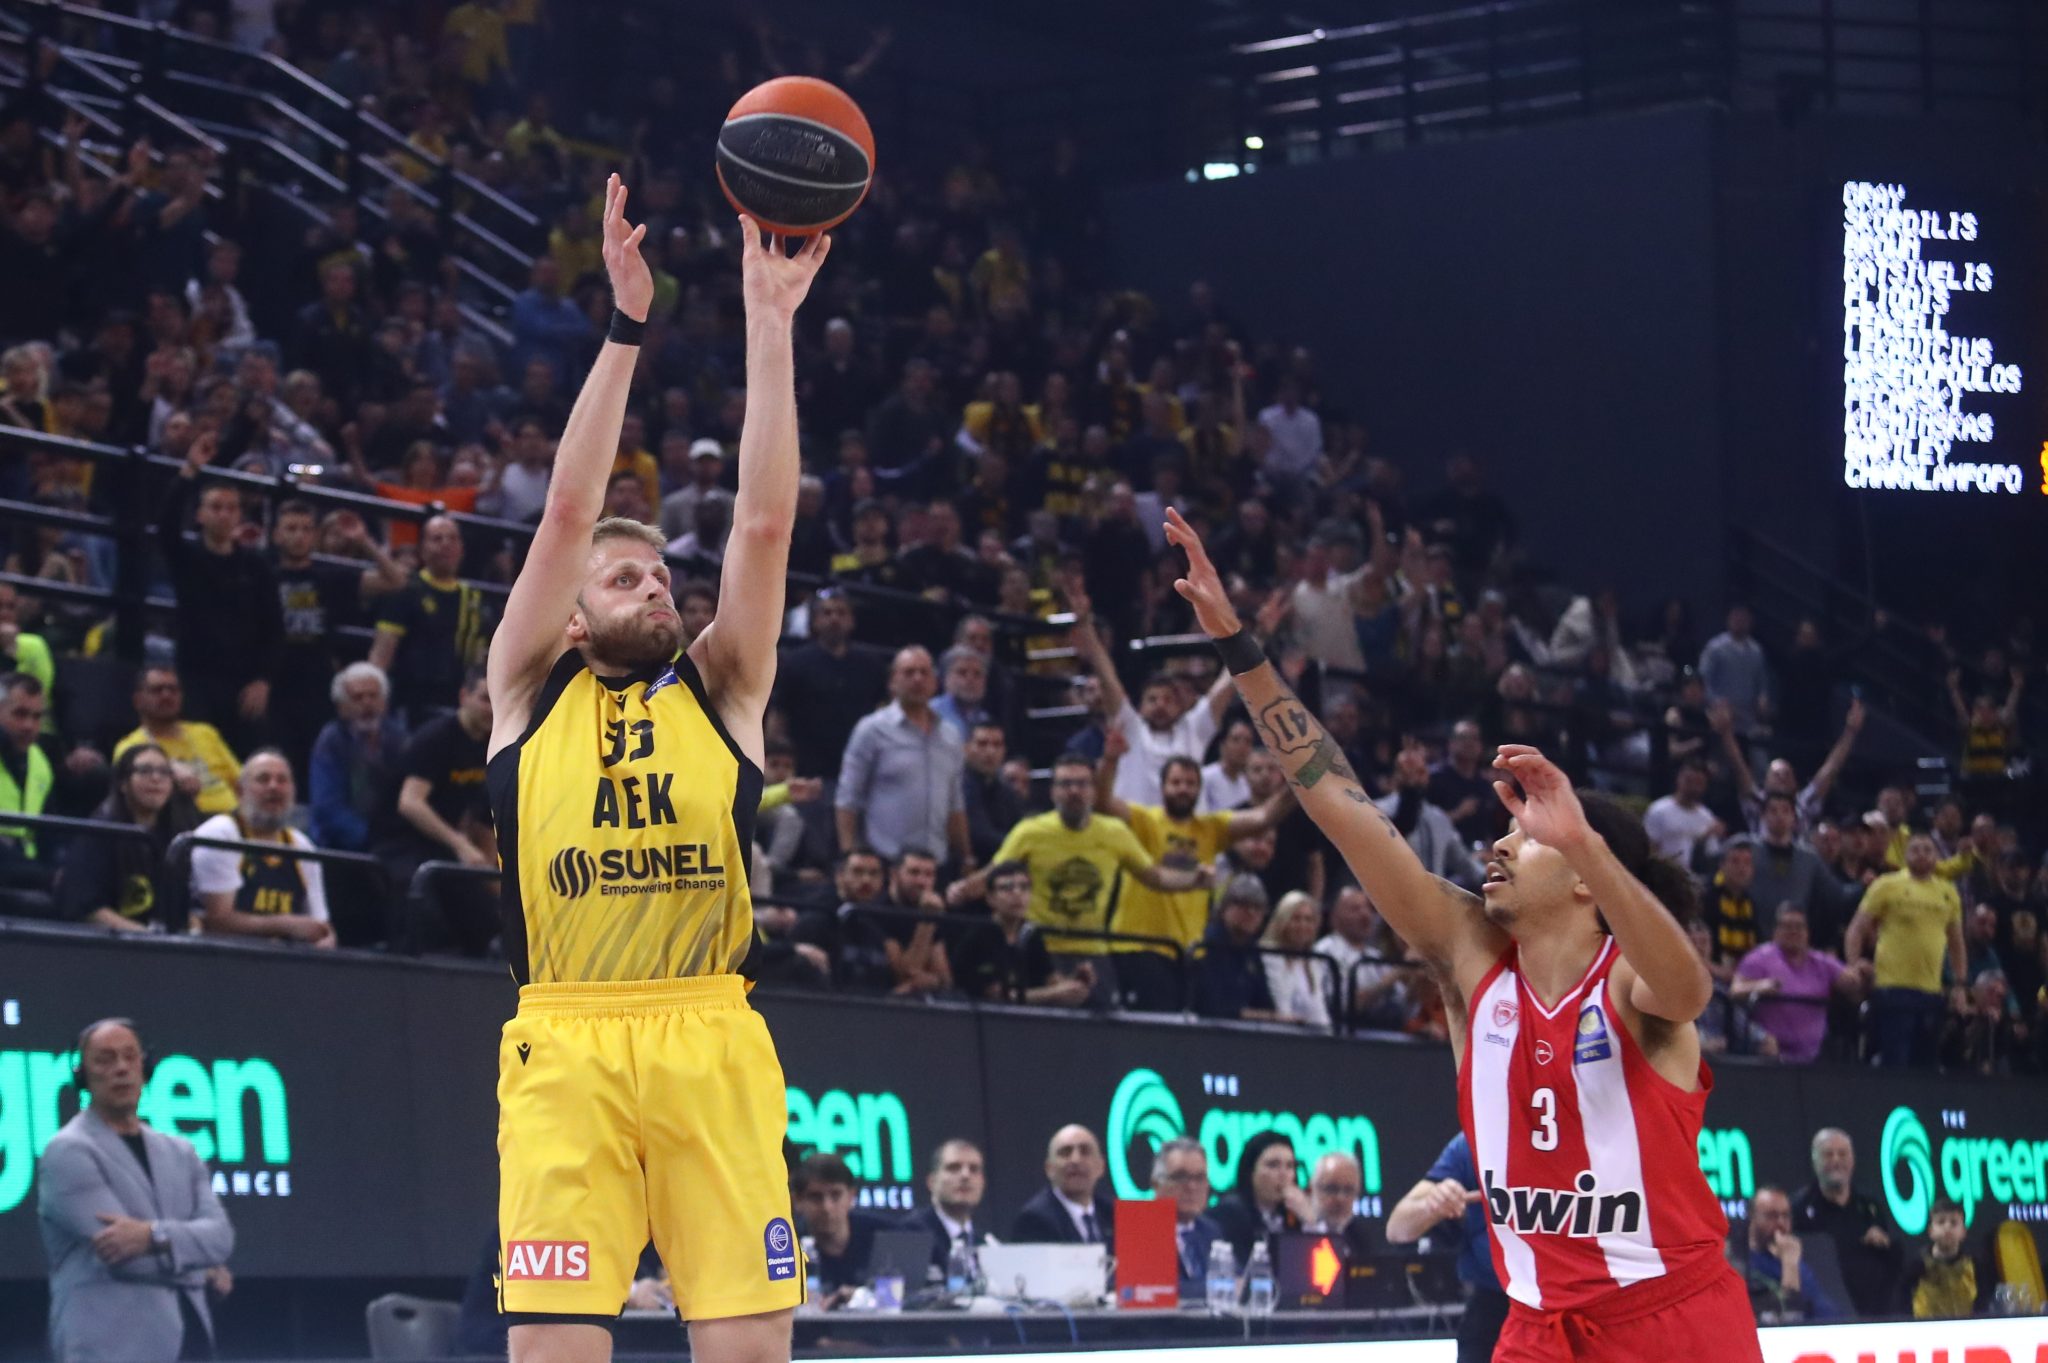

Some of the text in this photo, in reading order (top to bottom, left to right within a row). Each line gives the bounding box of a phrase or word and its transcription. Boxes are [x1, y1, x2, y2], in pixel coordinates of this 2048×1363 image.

[593, 773, 677, 829] AEK
[600, 844, 724, 880] SUNEL
[601, 879, 725, 896] Empowering Change
[1531, 1088, 1559, 1151] 3
[1485, 1170, 1641, 1237] bwin
[508, 1245, 587, 1277] AVIS
